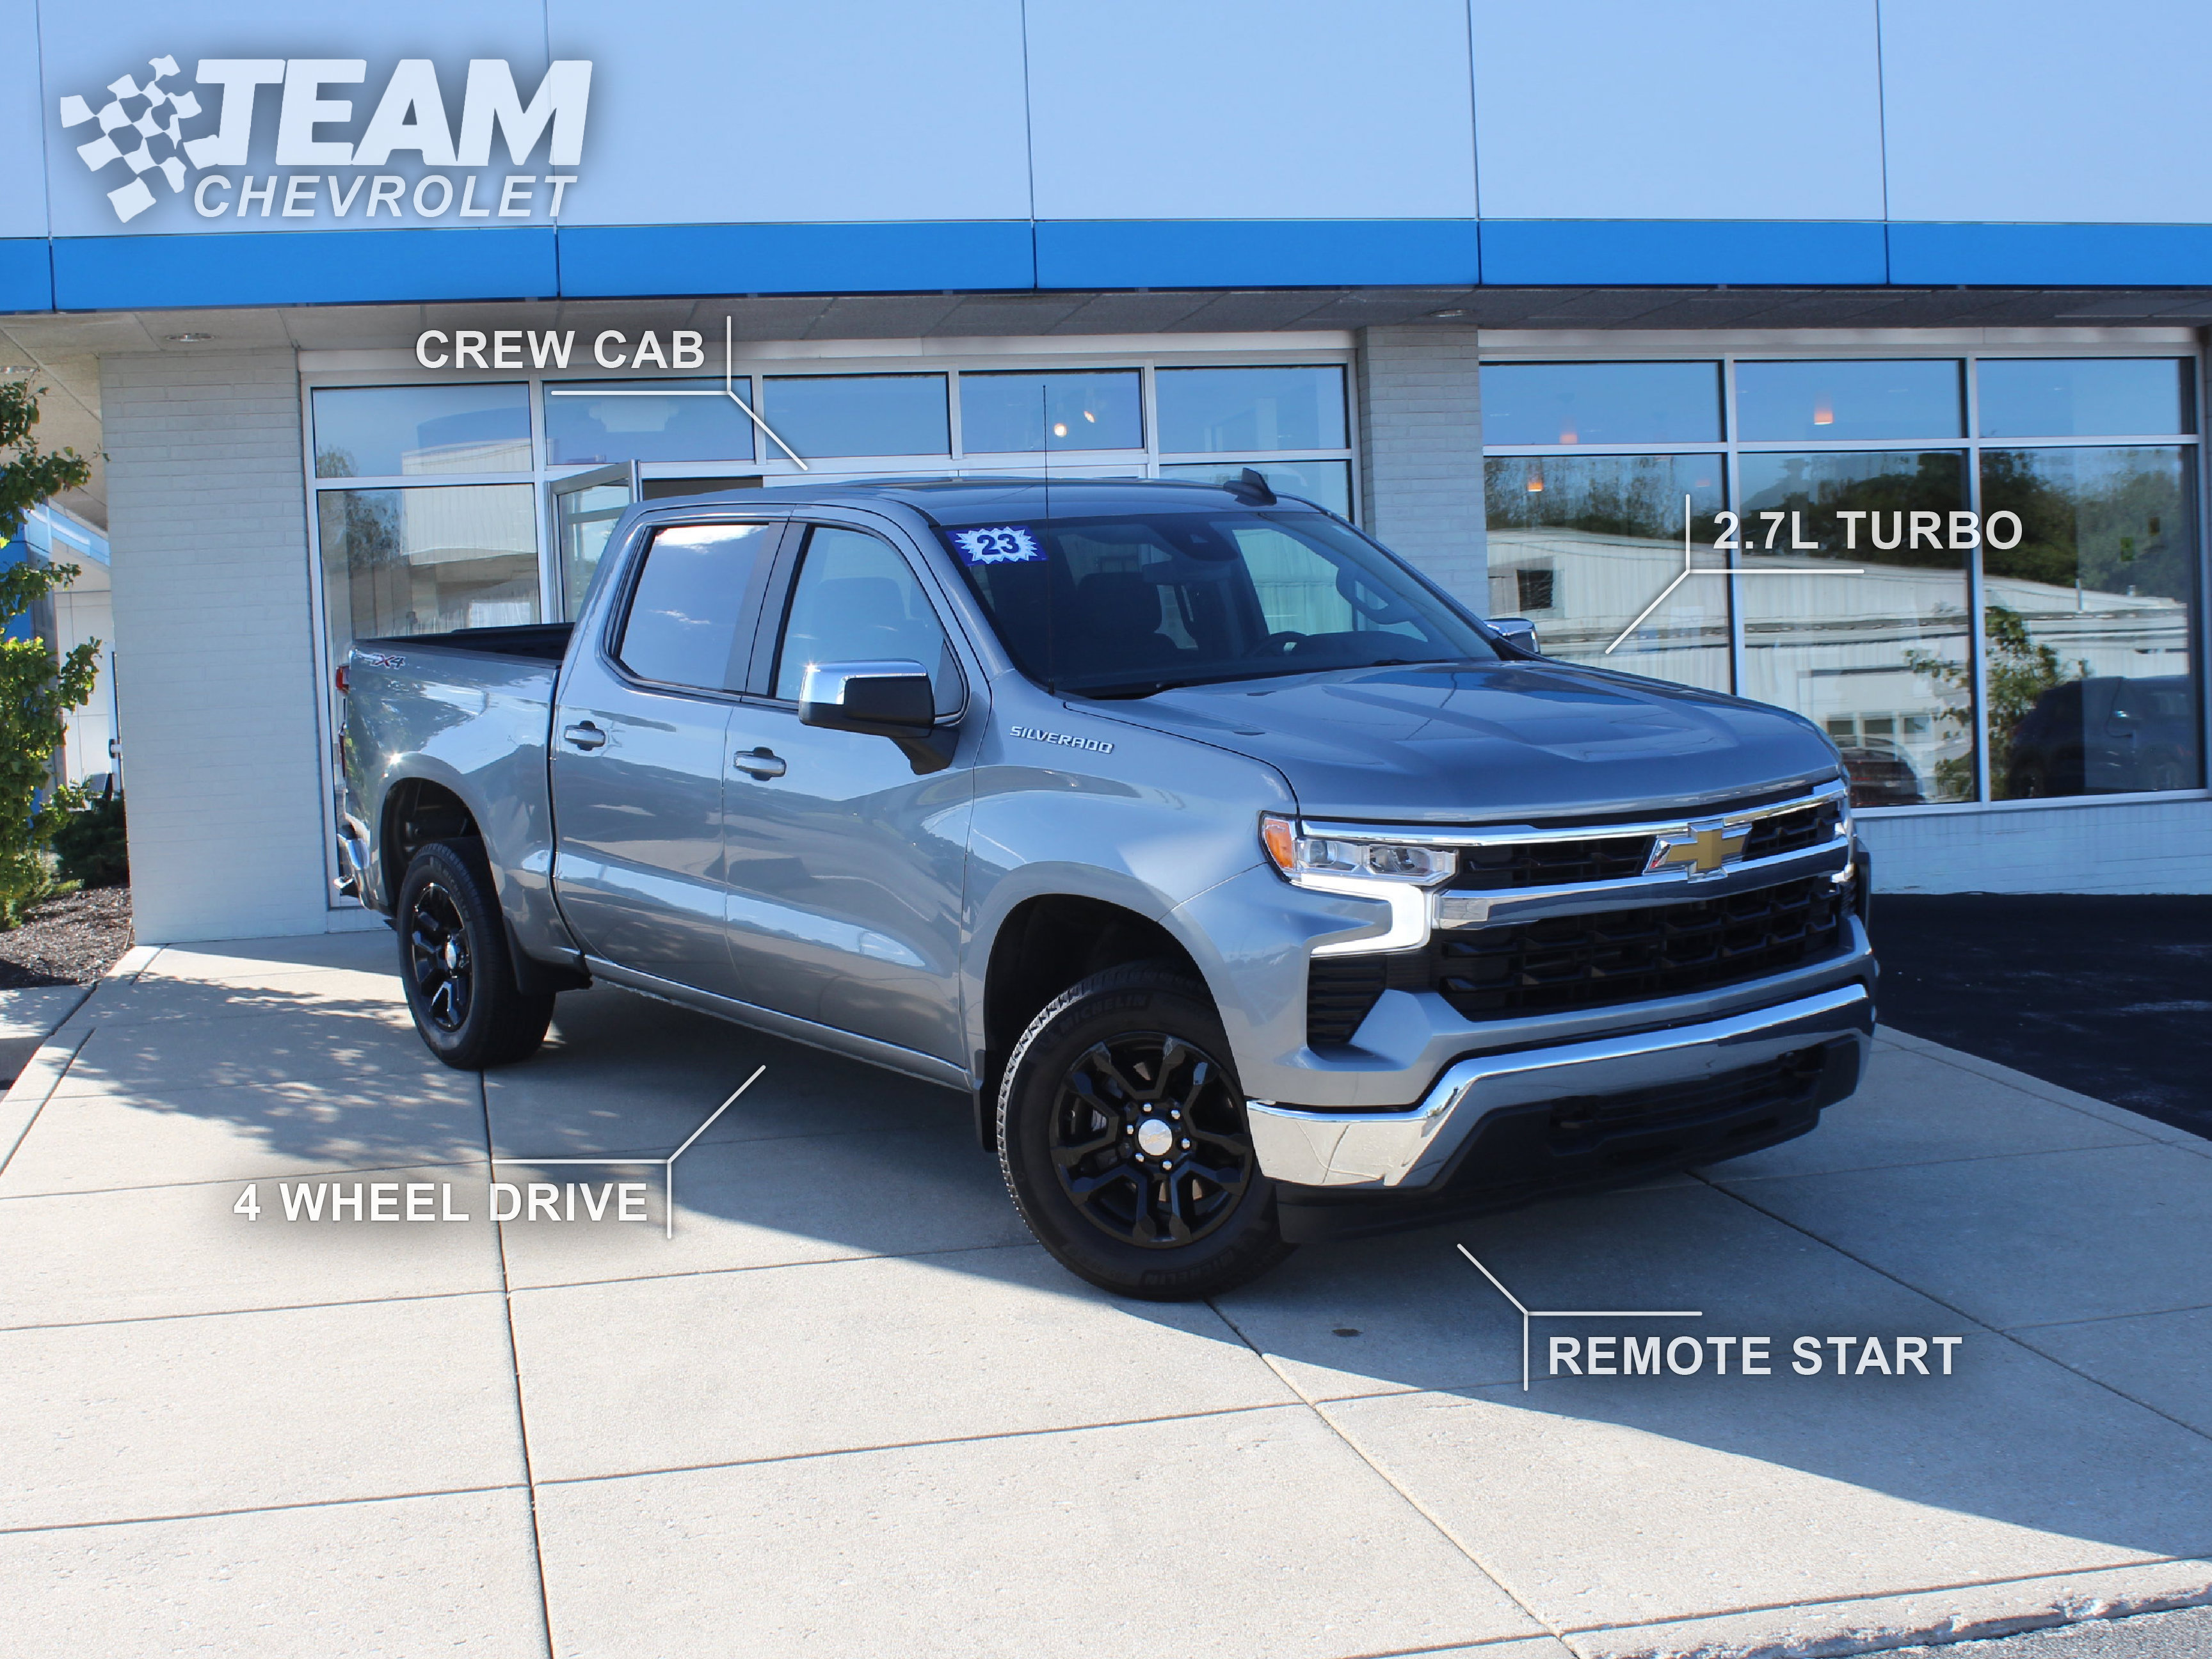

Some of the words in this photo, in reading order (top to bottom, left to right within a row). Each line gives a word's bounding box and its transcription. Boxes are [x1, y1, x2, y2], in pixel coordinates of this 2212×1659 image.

[977, 533, 1020, 555] 23
[1009, 726, 1115, 755] SILVERADO
[1059, 993, 1148, 1034] MICHELIN
